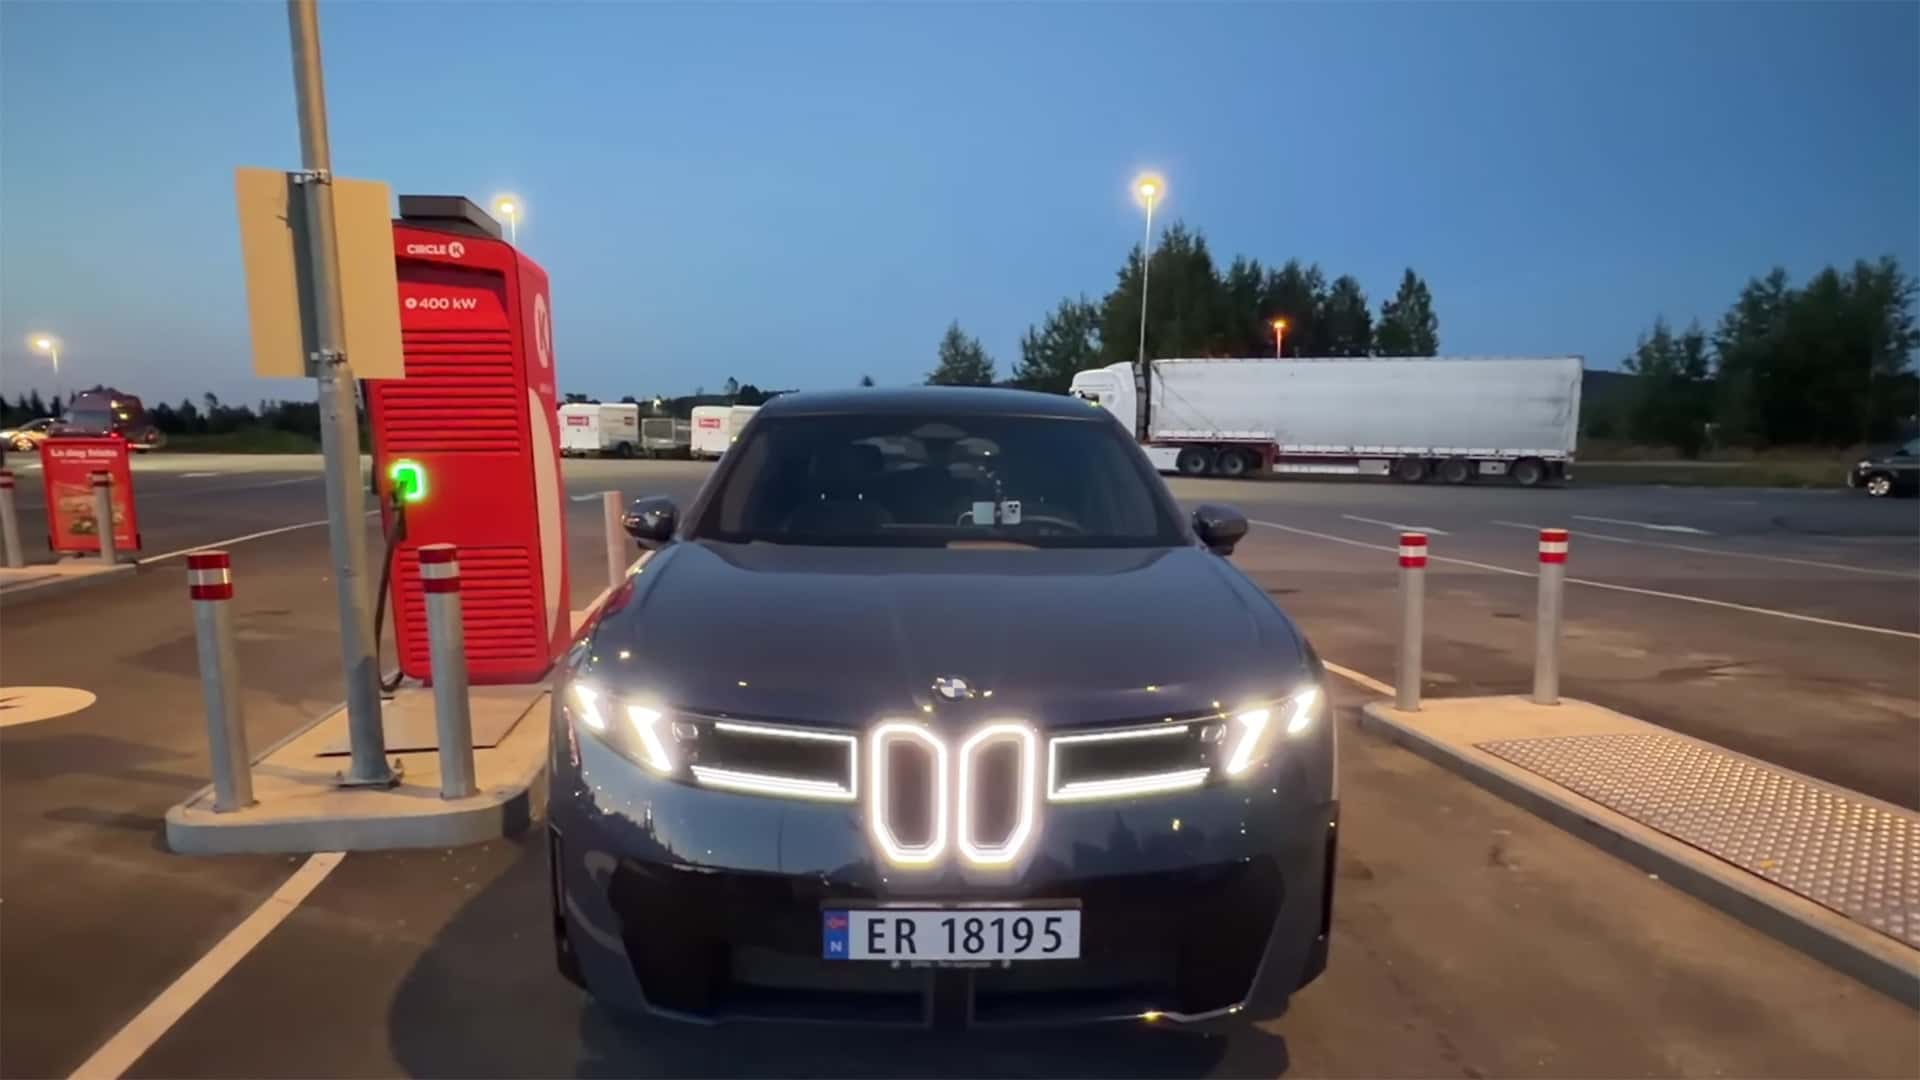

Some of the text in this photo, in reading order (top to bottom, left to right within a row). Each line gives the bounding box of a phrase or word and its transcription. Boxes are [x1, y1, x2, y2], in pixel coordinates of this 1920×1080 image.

[406, 241, 465, 258] CIRCLE K
[419, 297, 477, 309] 400 kW
[867, 916, 1063, 954] ER 18195
[830, 940, 842, 952] N
